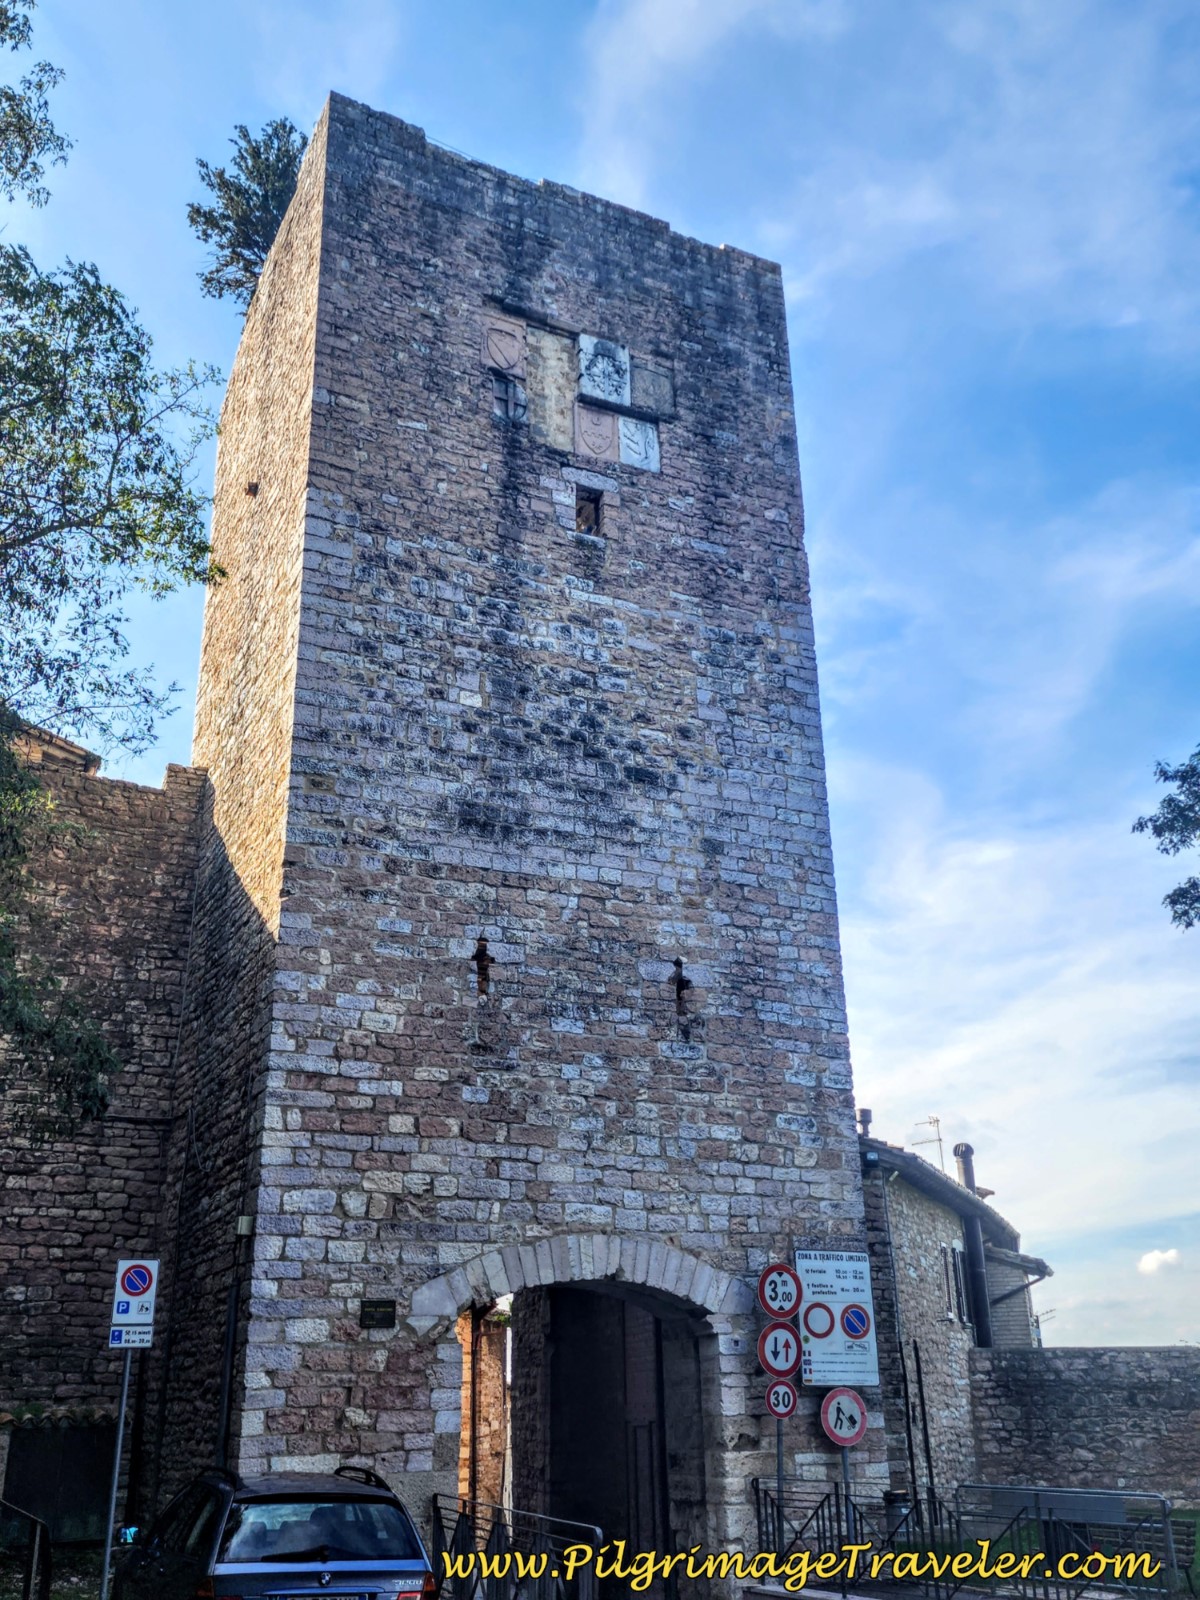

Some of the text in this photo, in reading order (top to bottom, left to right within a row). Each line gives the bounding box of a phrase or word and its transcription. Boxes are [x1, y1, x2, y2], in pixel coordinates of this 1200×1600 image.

[819, 1254, 844, 1262] TRAFFICO
[119, 1302, 127, 1313] P
[772, 1390, 791, 1408] 30
